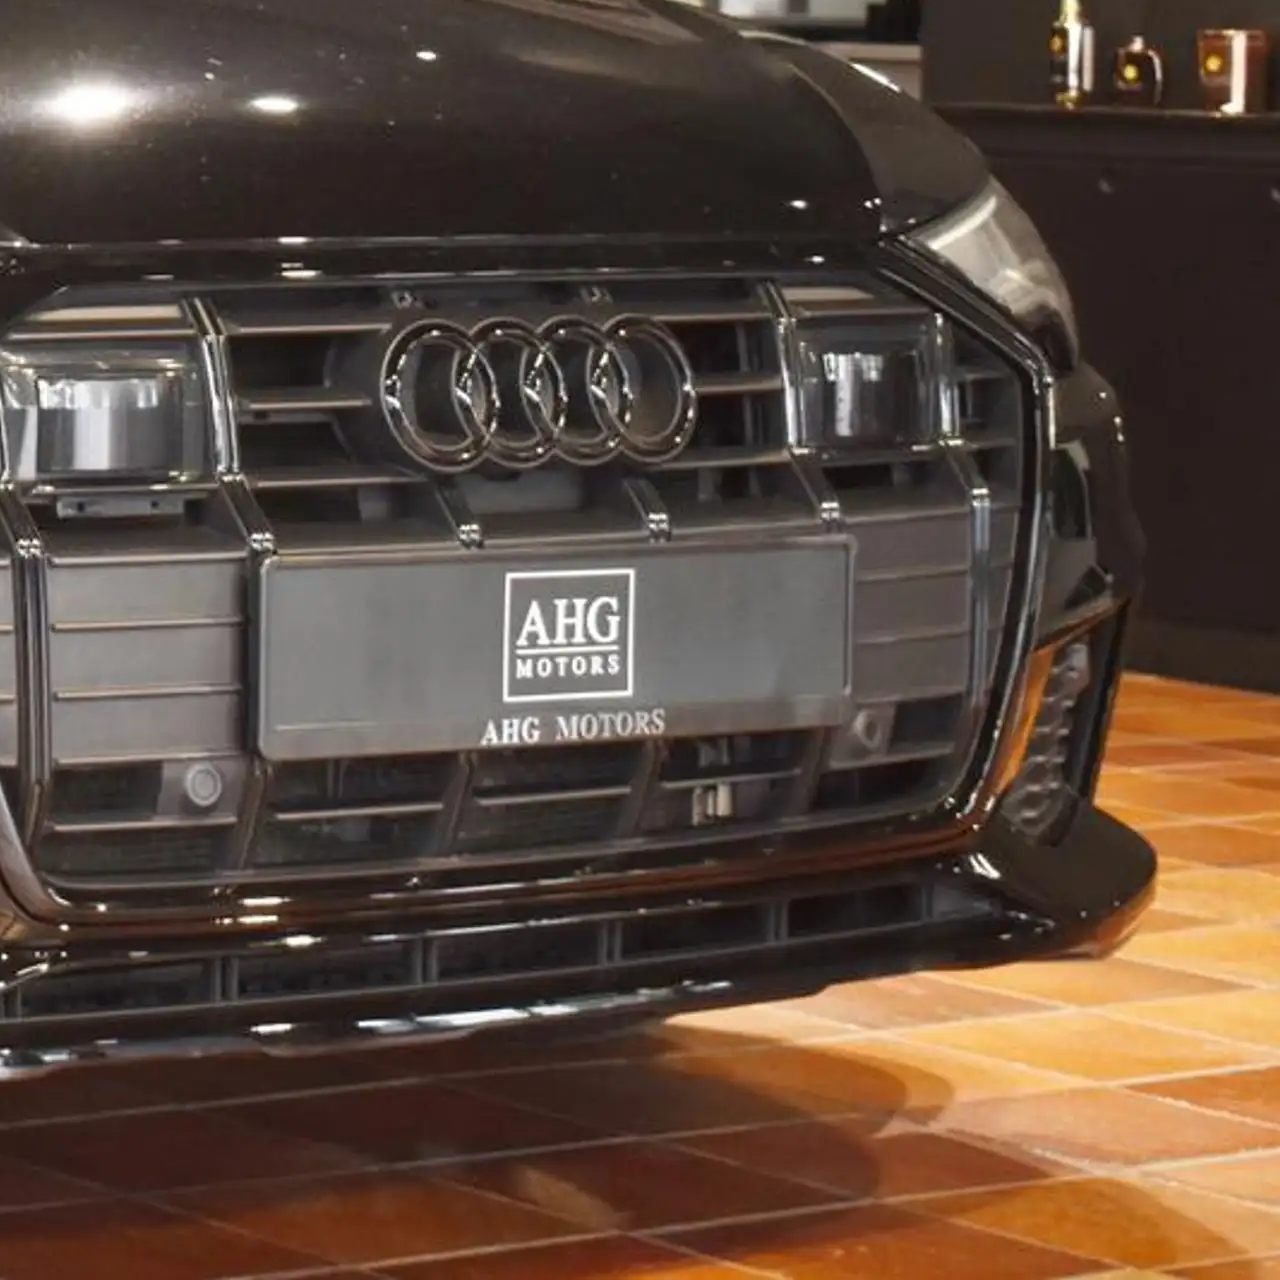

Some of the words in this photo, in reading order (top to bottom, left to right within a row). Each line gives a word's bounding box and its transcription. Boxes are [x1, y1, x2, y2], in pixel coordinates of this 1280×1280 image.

[515, 596, 621, 646] AHG
[515, 654, 621, 679] MOTORS
[480, 716, 541, 746] AHG
[555, 708, 666, 741] MOTORS
